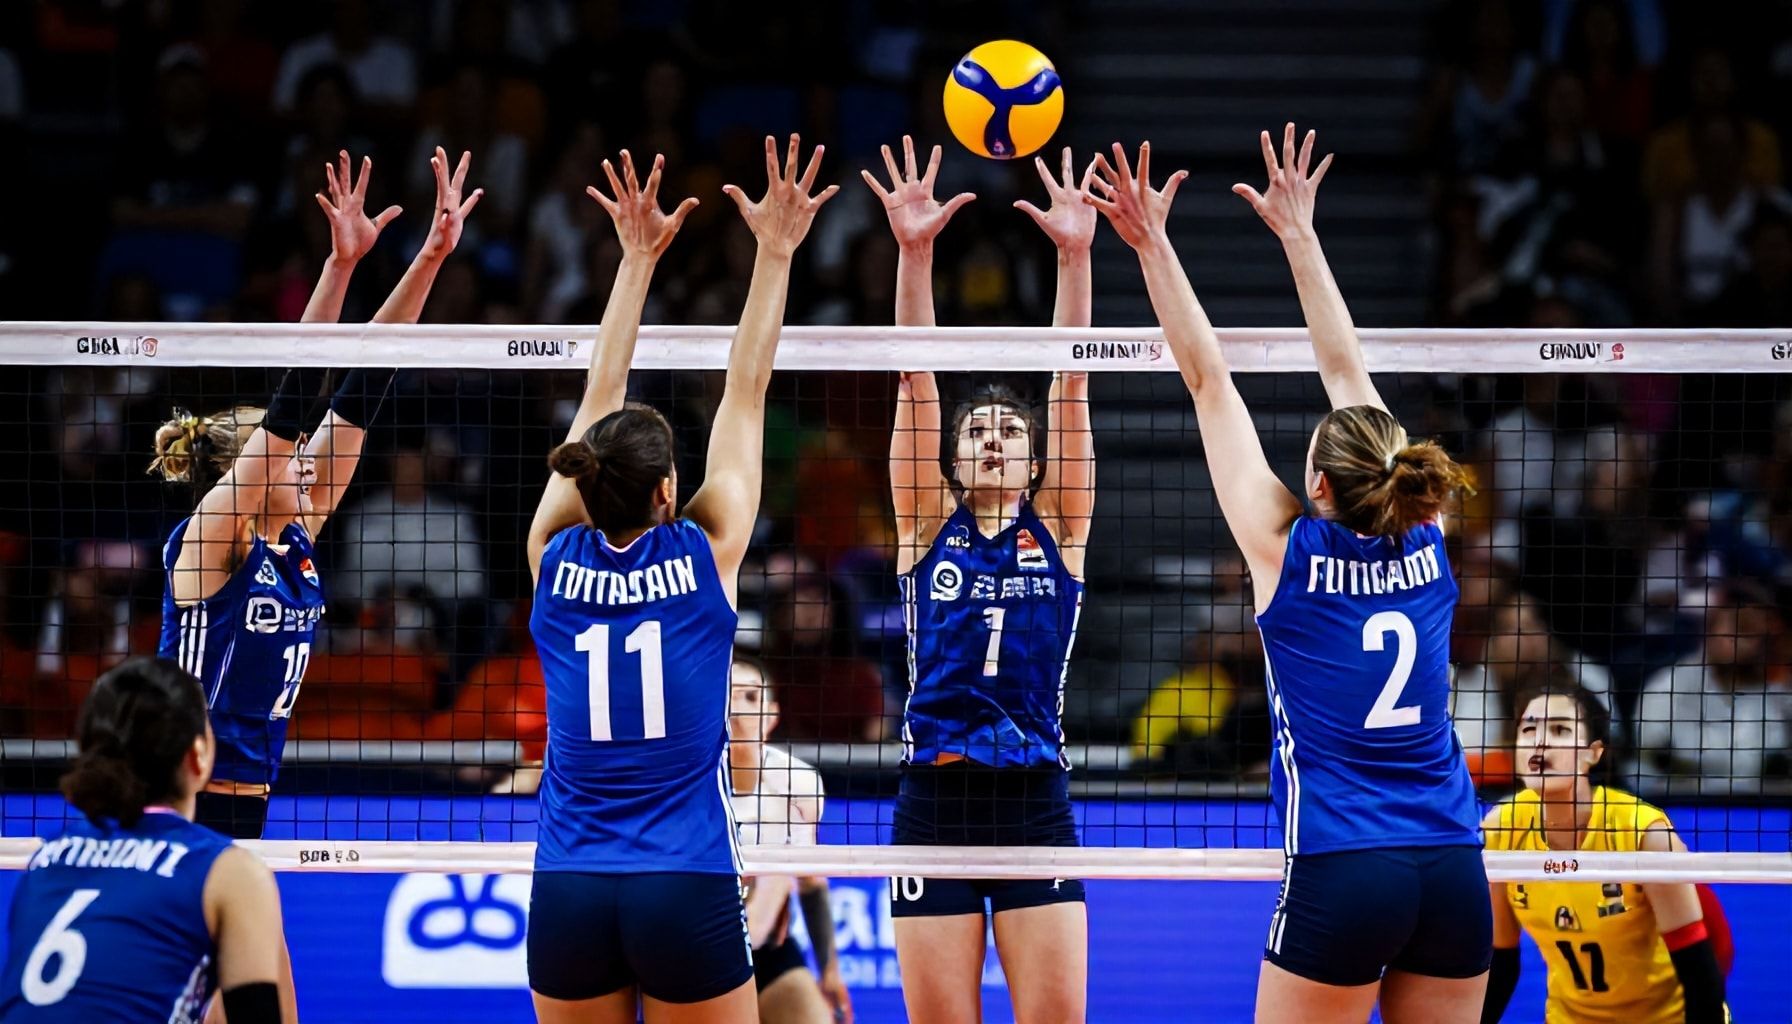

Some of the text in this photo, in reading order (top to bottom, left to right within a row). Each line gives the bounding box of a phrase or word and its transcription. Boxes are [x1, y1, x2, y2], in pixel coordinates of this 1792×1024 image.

[575, 621, 666, 742] 11
[983, 607, 1006, 677] 1
[1362, 611, 1422, 729] 2
[21, 888, 100, 1006] 6
